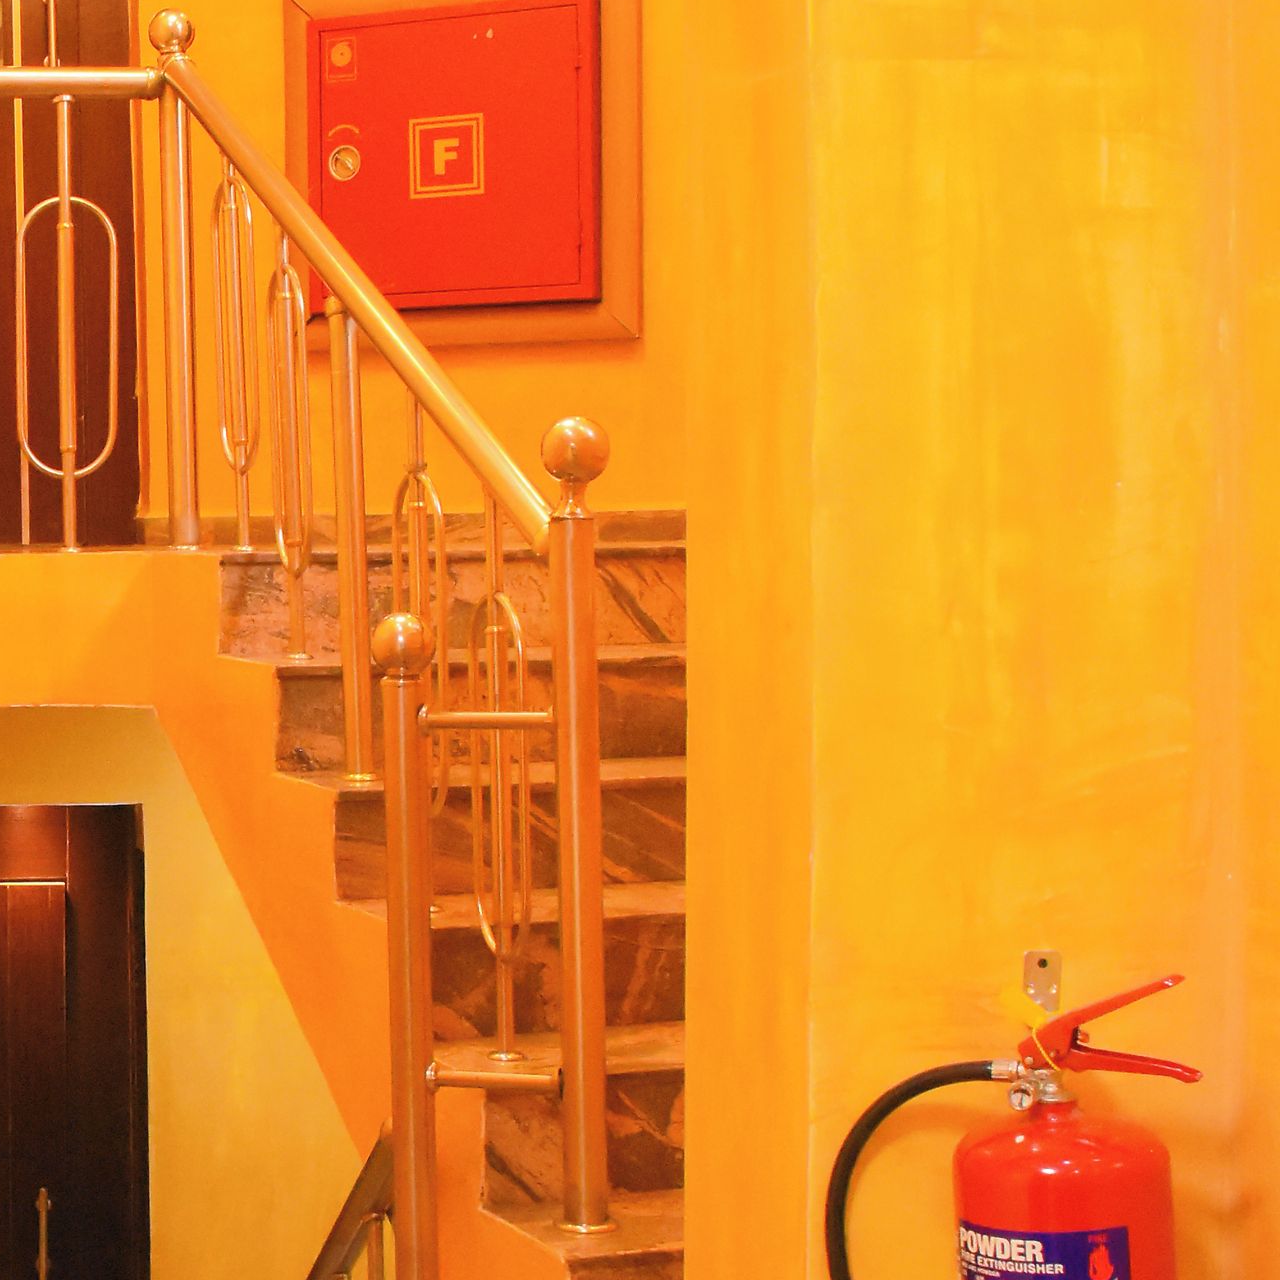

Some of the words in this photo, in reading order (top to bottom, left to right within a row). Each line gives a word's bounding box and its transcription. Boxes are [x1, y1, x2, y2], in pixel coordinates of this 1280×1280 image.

[434, 138, 460, 176] F
[959, 1226, 1044, 1263] POWDER
[976, 1255, 1064, 1275] EXTINGUISHER
